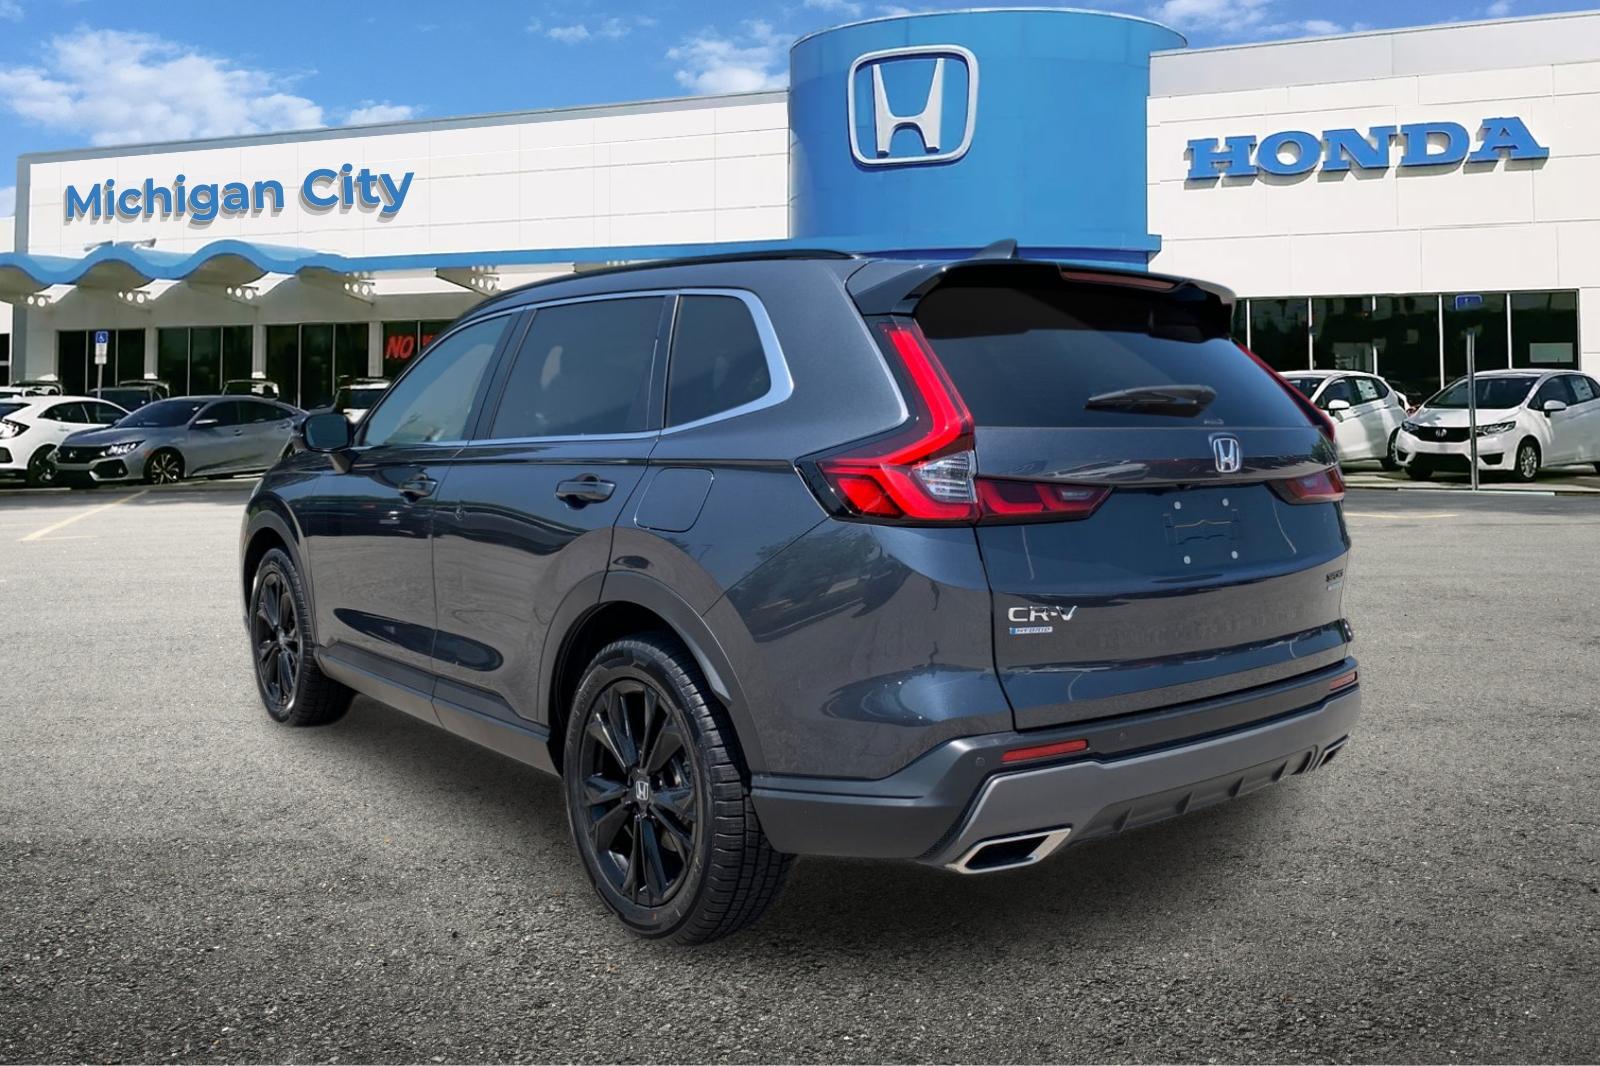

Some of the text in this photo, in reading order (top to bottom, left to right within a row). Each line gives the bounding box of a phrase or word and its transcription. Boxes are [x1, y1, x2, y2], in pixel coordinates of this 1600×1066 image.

[1187, 116, 1549, 180] HONDA
[66, 164, 414, 222] Michigan City
[385, 335, 415, 359] NO
[1008, 605, 1077, 621] CR-V
